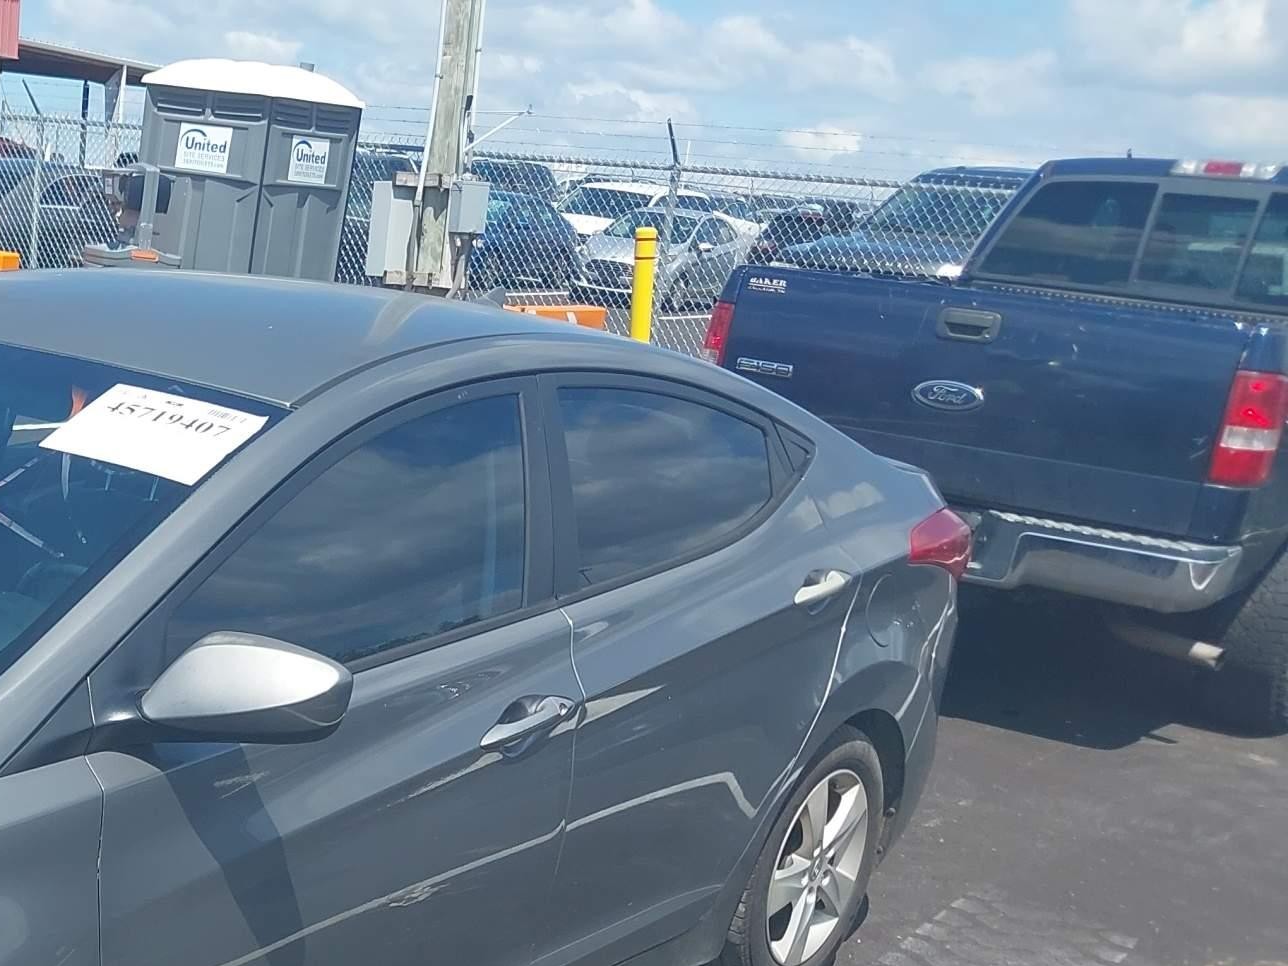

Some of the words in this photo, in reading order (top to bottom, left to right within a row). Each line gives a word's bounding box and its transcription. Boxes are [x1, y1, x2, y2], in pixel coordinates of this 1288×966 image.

[185, 135, 227, 154] United
[296, 148, 327, 165] United
[749, 277, 788, 288] BAKER
[927, 385, 967, 405] Ford
[107, 402, 232, 437] 45719407
